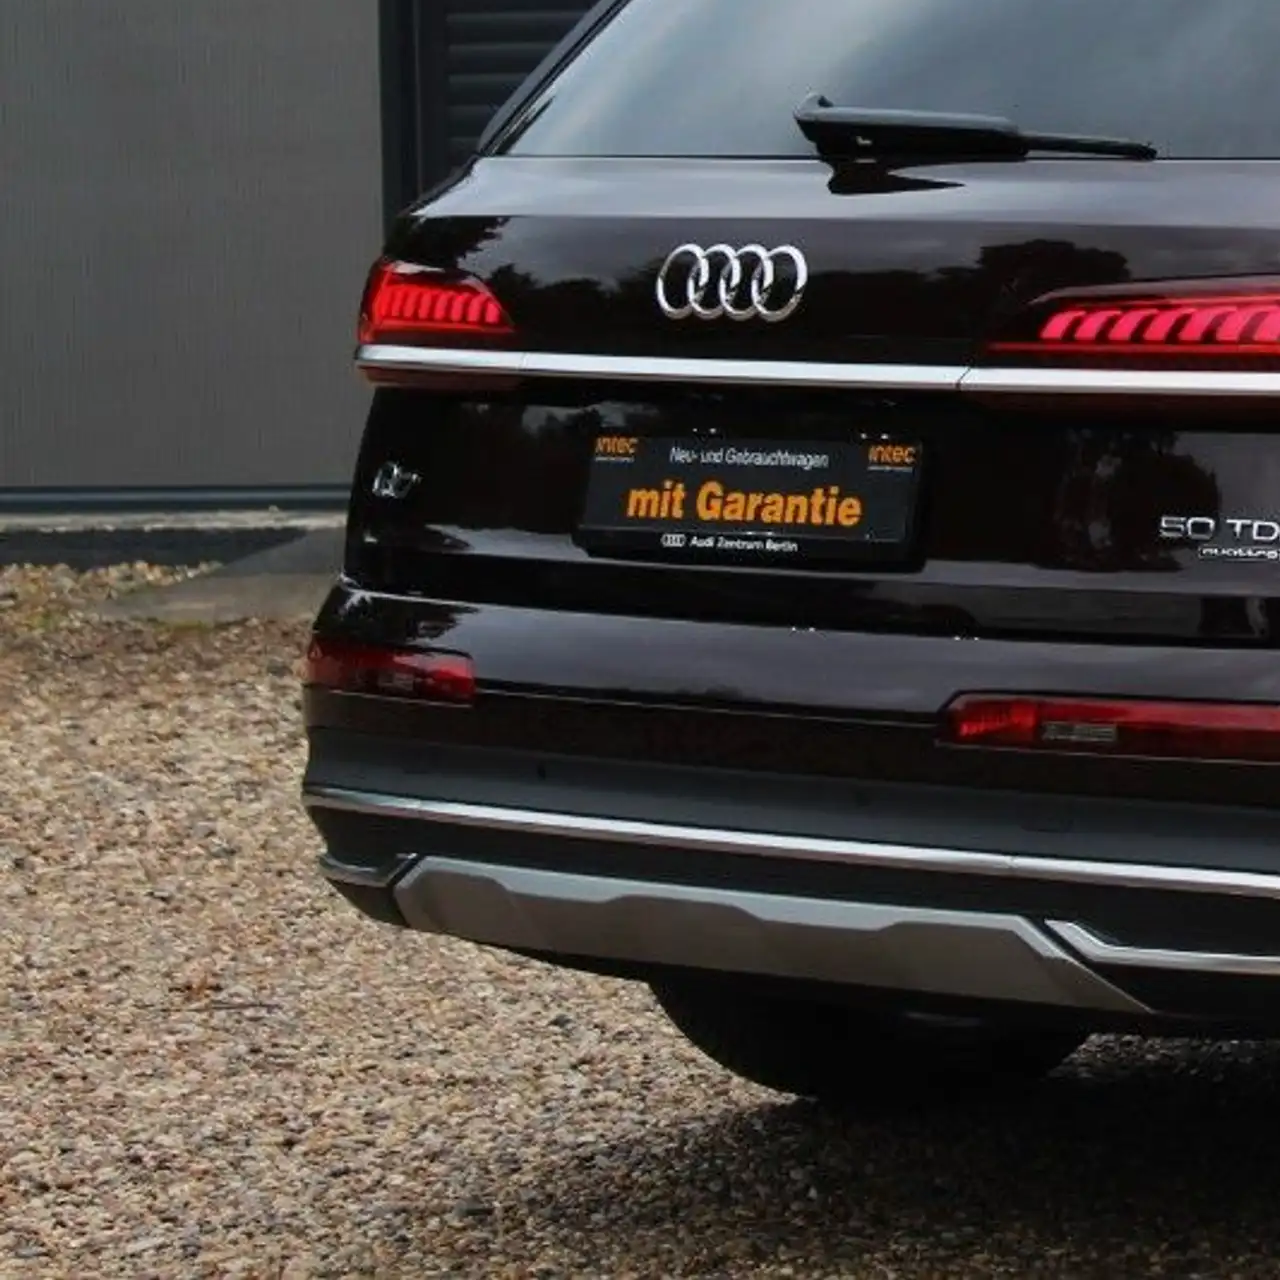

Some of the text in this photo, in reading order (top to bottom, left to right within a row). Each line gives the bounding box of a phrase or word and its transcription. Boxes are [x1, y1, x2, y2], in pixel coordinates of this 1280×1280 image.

[700, 448, 724, 464] und
[626, 478, 863, 527] mit Garantie
[1159, 515, 1216, 540] 50
[689, 535, 799, 552] Audi Zentrum Berlin
